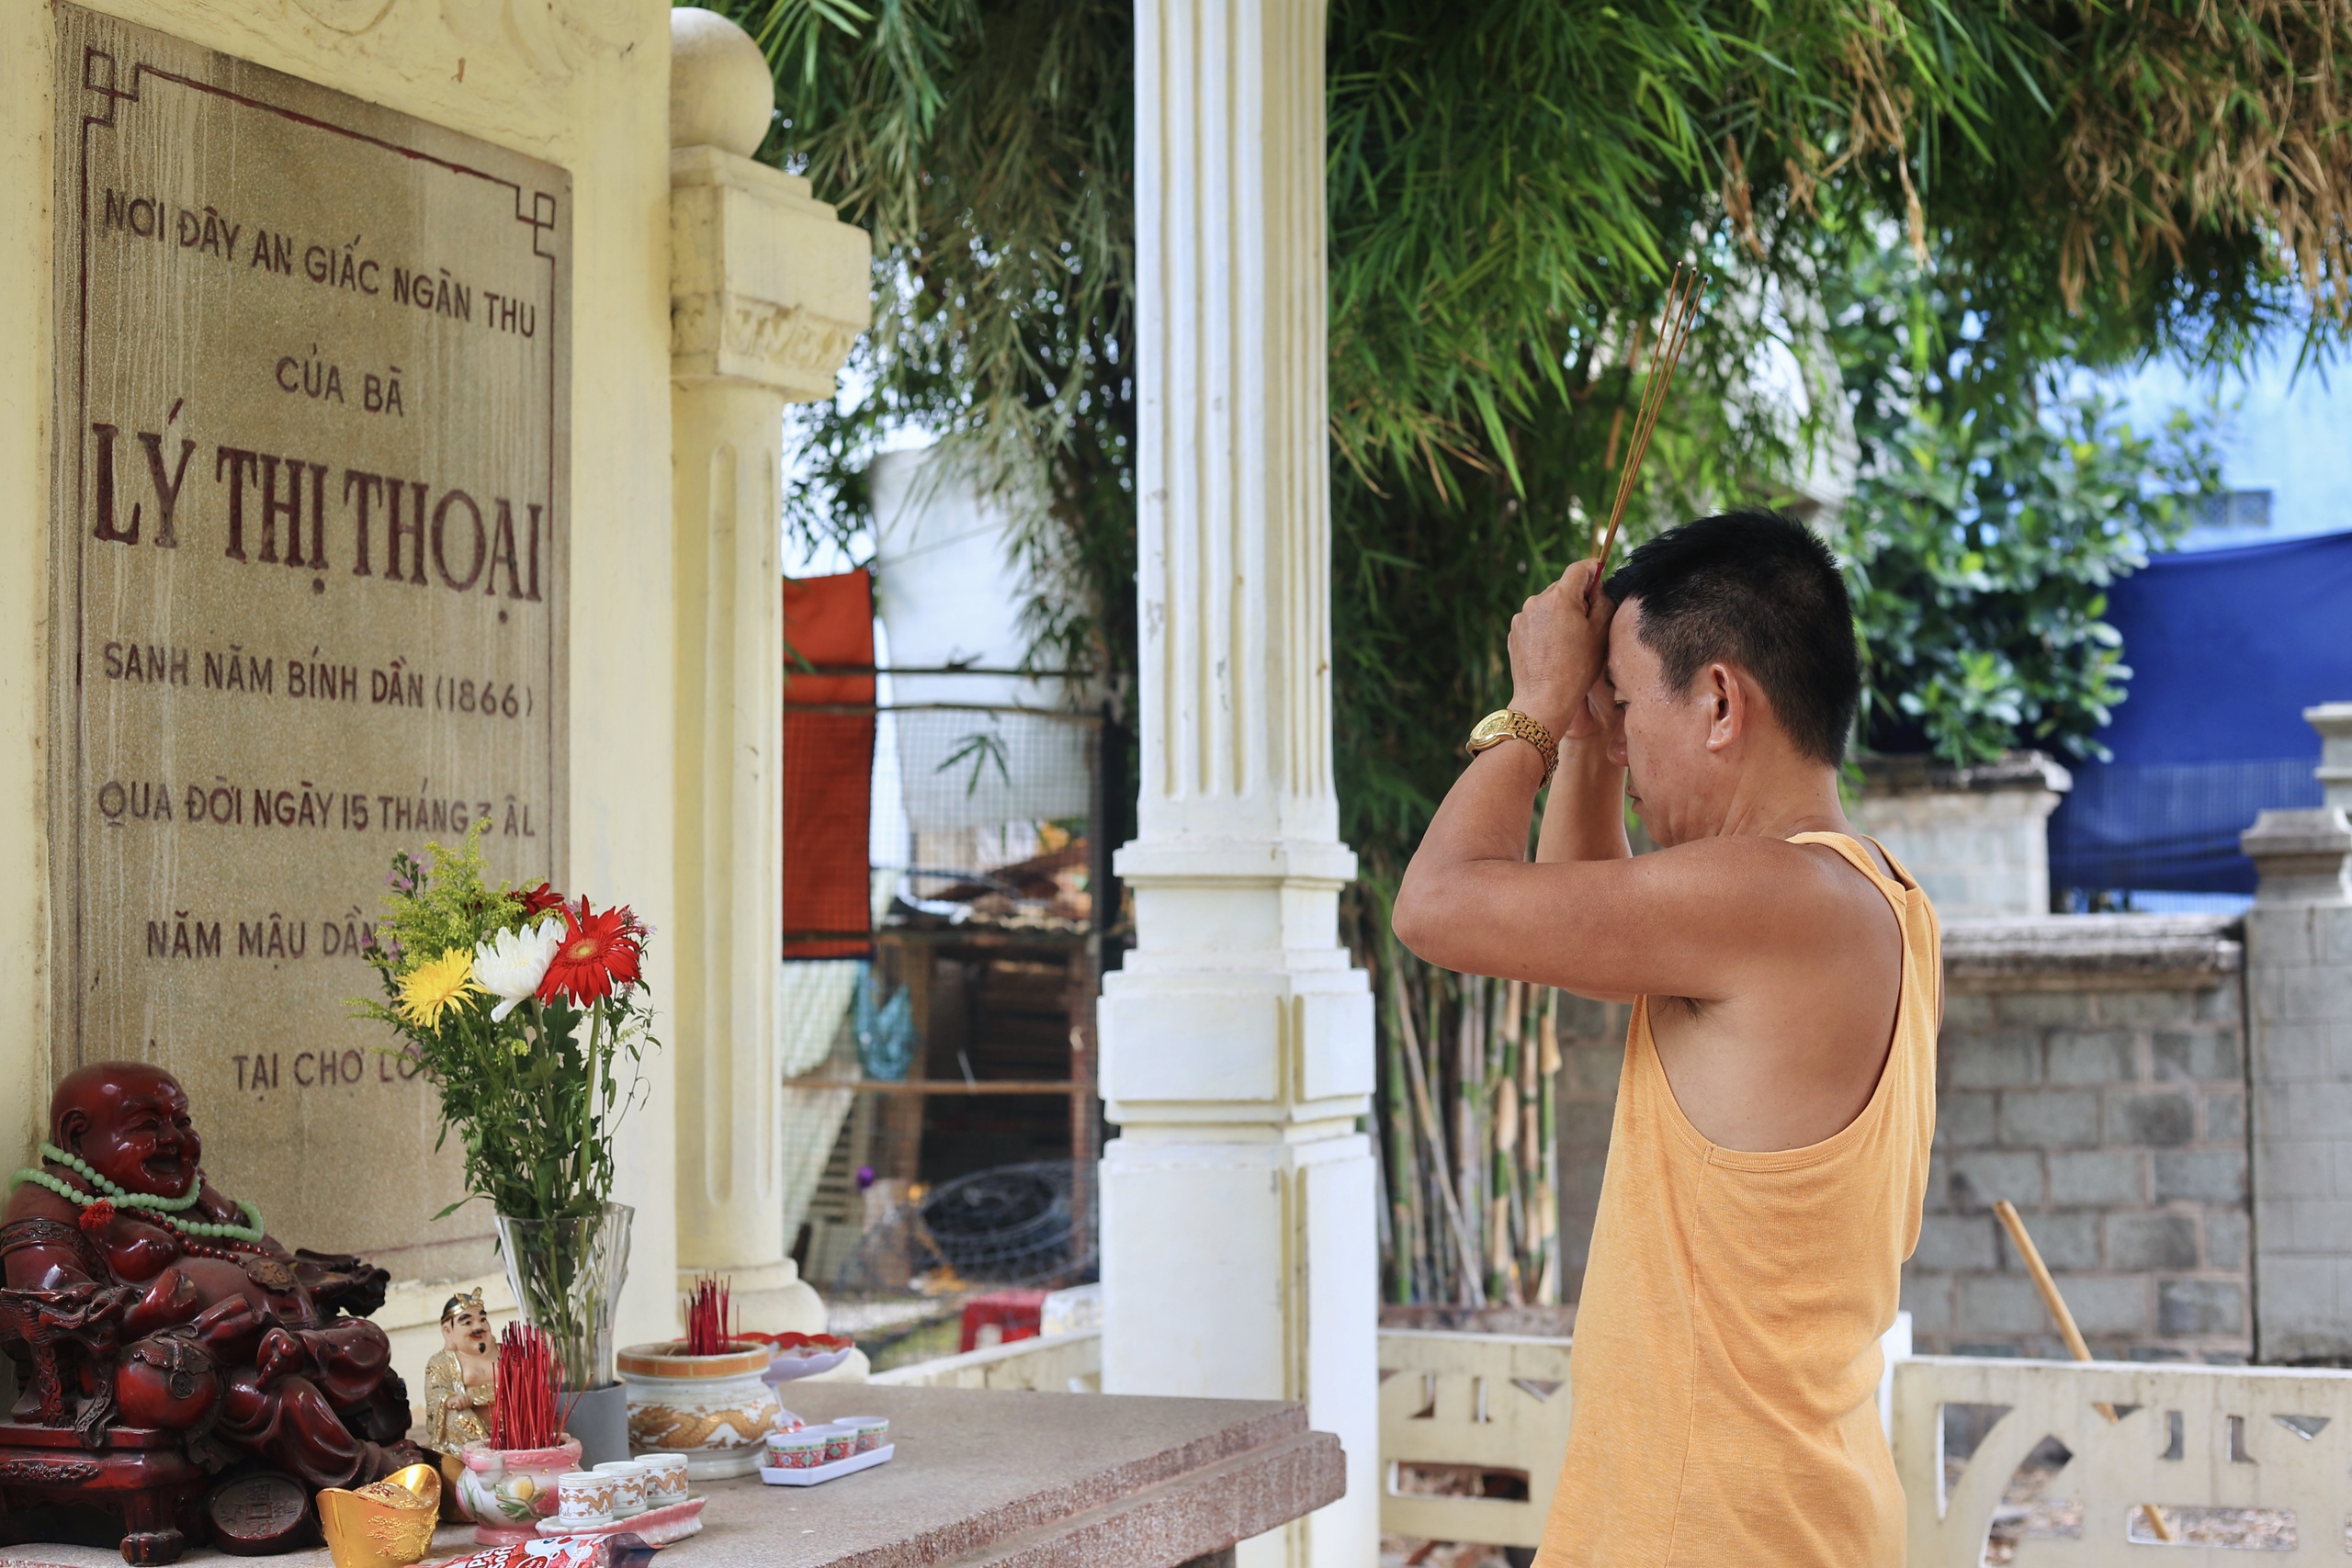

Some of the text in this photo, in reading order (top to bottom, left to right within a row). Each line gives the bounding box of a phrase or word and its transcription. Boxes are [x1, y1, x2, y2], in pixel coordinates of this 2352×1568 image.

[105, 187, 165, 243] NƠI
[252, 230, 292, 276] AN
[305, 234, 379, 296] GIẤC
[393, 267, 471, 322] NGÀN
[484, 291, 536, 338] THU
[276, 342, 345, 404] CỦA
[93, 397, 542, 625] LÝ THỊ THOẠI
[104, 642, 533, 717] SANH NĂM BÍNH DẦN (1866)
[98, 781, 172, 827] QUA
[185, 775, 242, 825] ĐỜI
[254, 781, 334, 829] NGÀY
[343, 794, 368, 830] 15
[378, 777, 469, 835] THÁNG
[147, 909, 221, 959] NĂM
[238, 913, 306, 969] MẬU
[232, 1052, 278, 1102] TẠI
